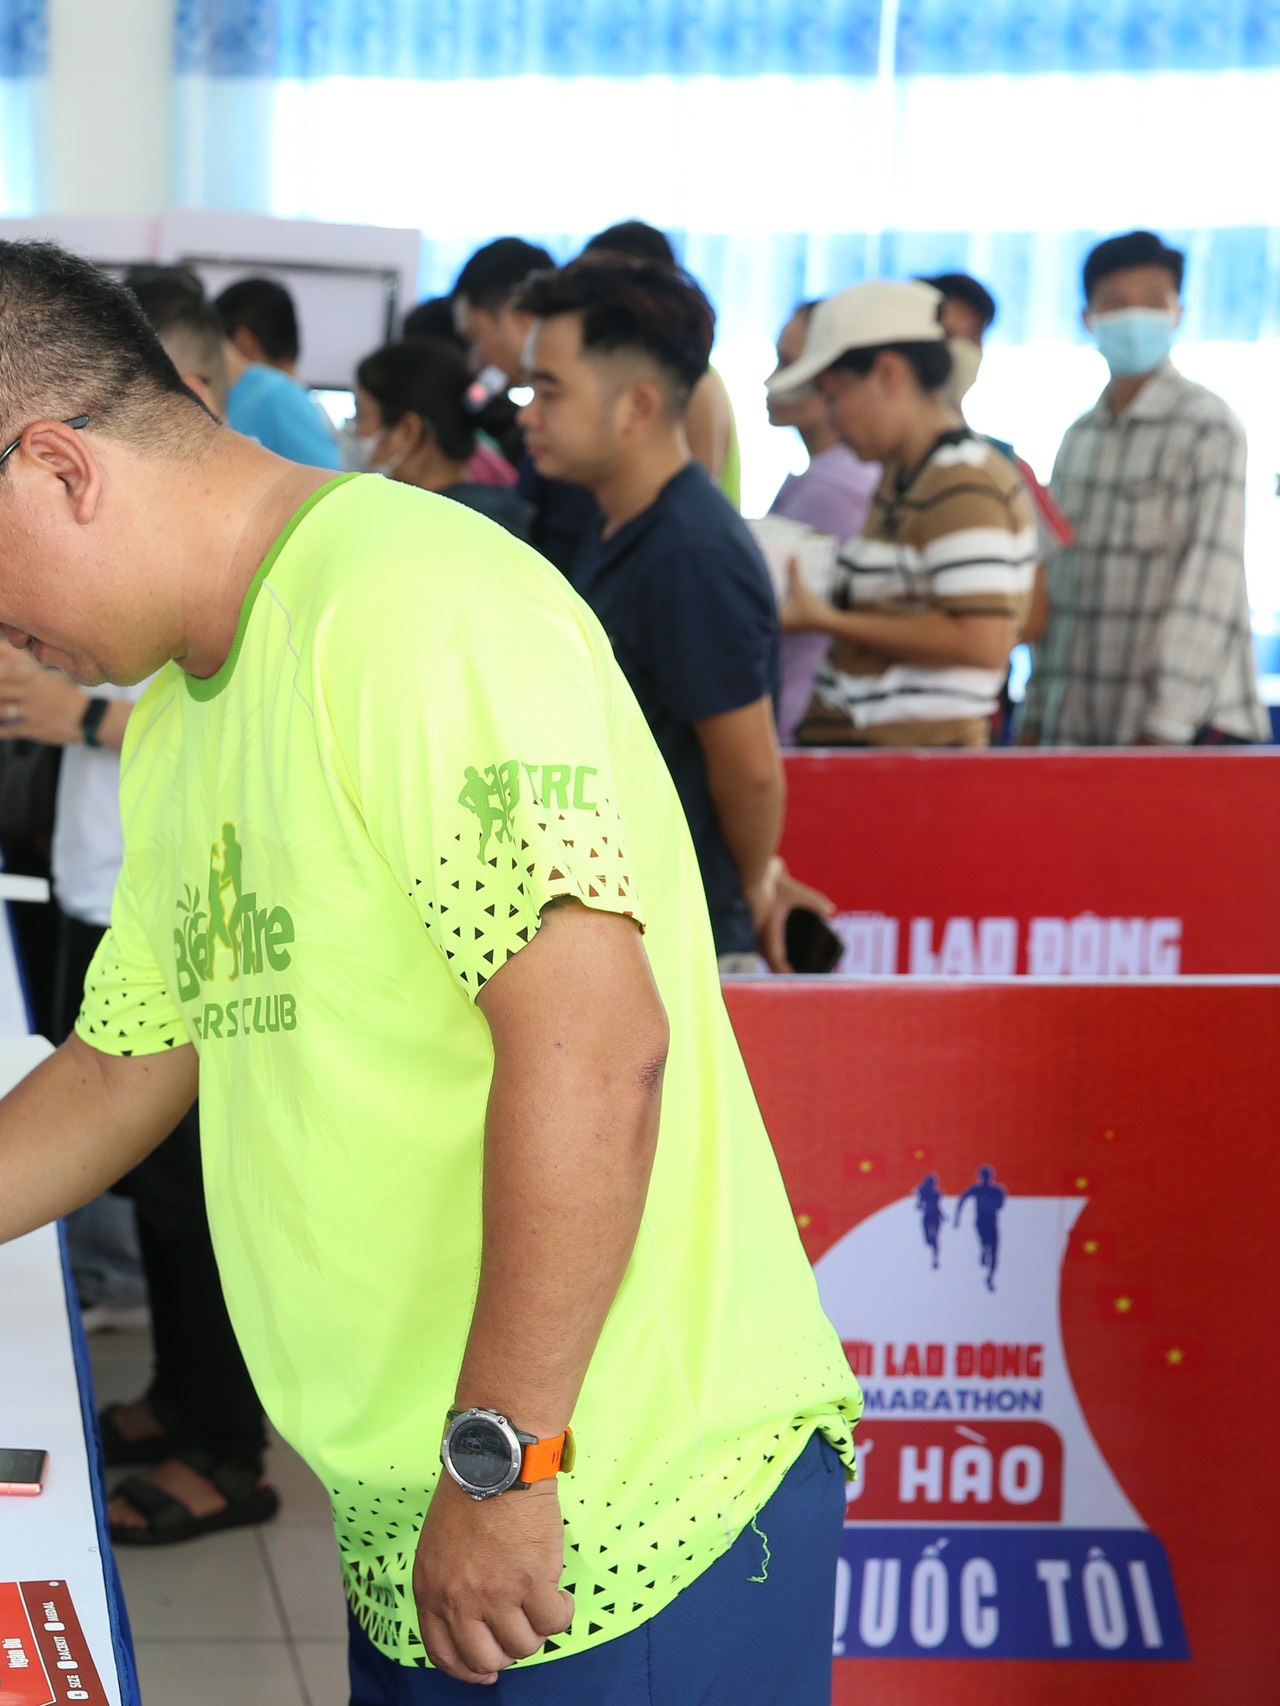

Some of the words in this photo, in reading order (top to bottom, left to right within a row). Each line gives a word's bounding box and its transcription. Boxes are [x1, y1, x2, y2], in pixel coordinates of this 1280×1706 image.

[242, 993, 297, 1036] CLUB
[885, 1343, 945, 1378] LAO
[863, 1388, 1043, 1413] MARATHON
[899, 1424, 1045, 1506] HÀO
[42, 1600, 60, 1622] MEDAL
[1036, 1545, 1163, 1650] TÔI
[53, 1635, 72, 1661] RACEKIT
[66, 1674, 83, 1689] SIZE
